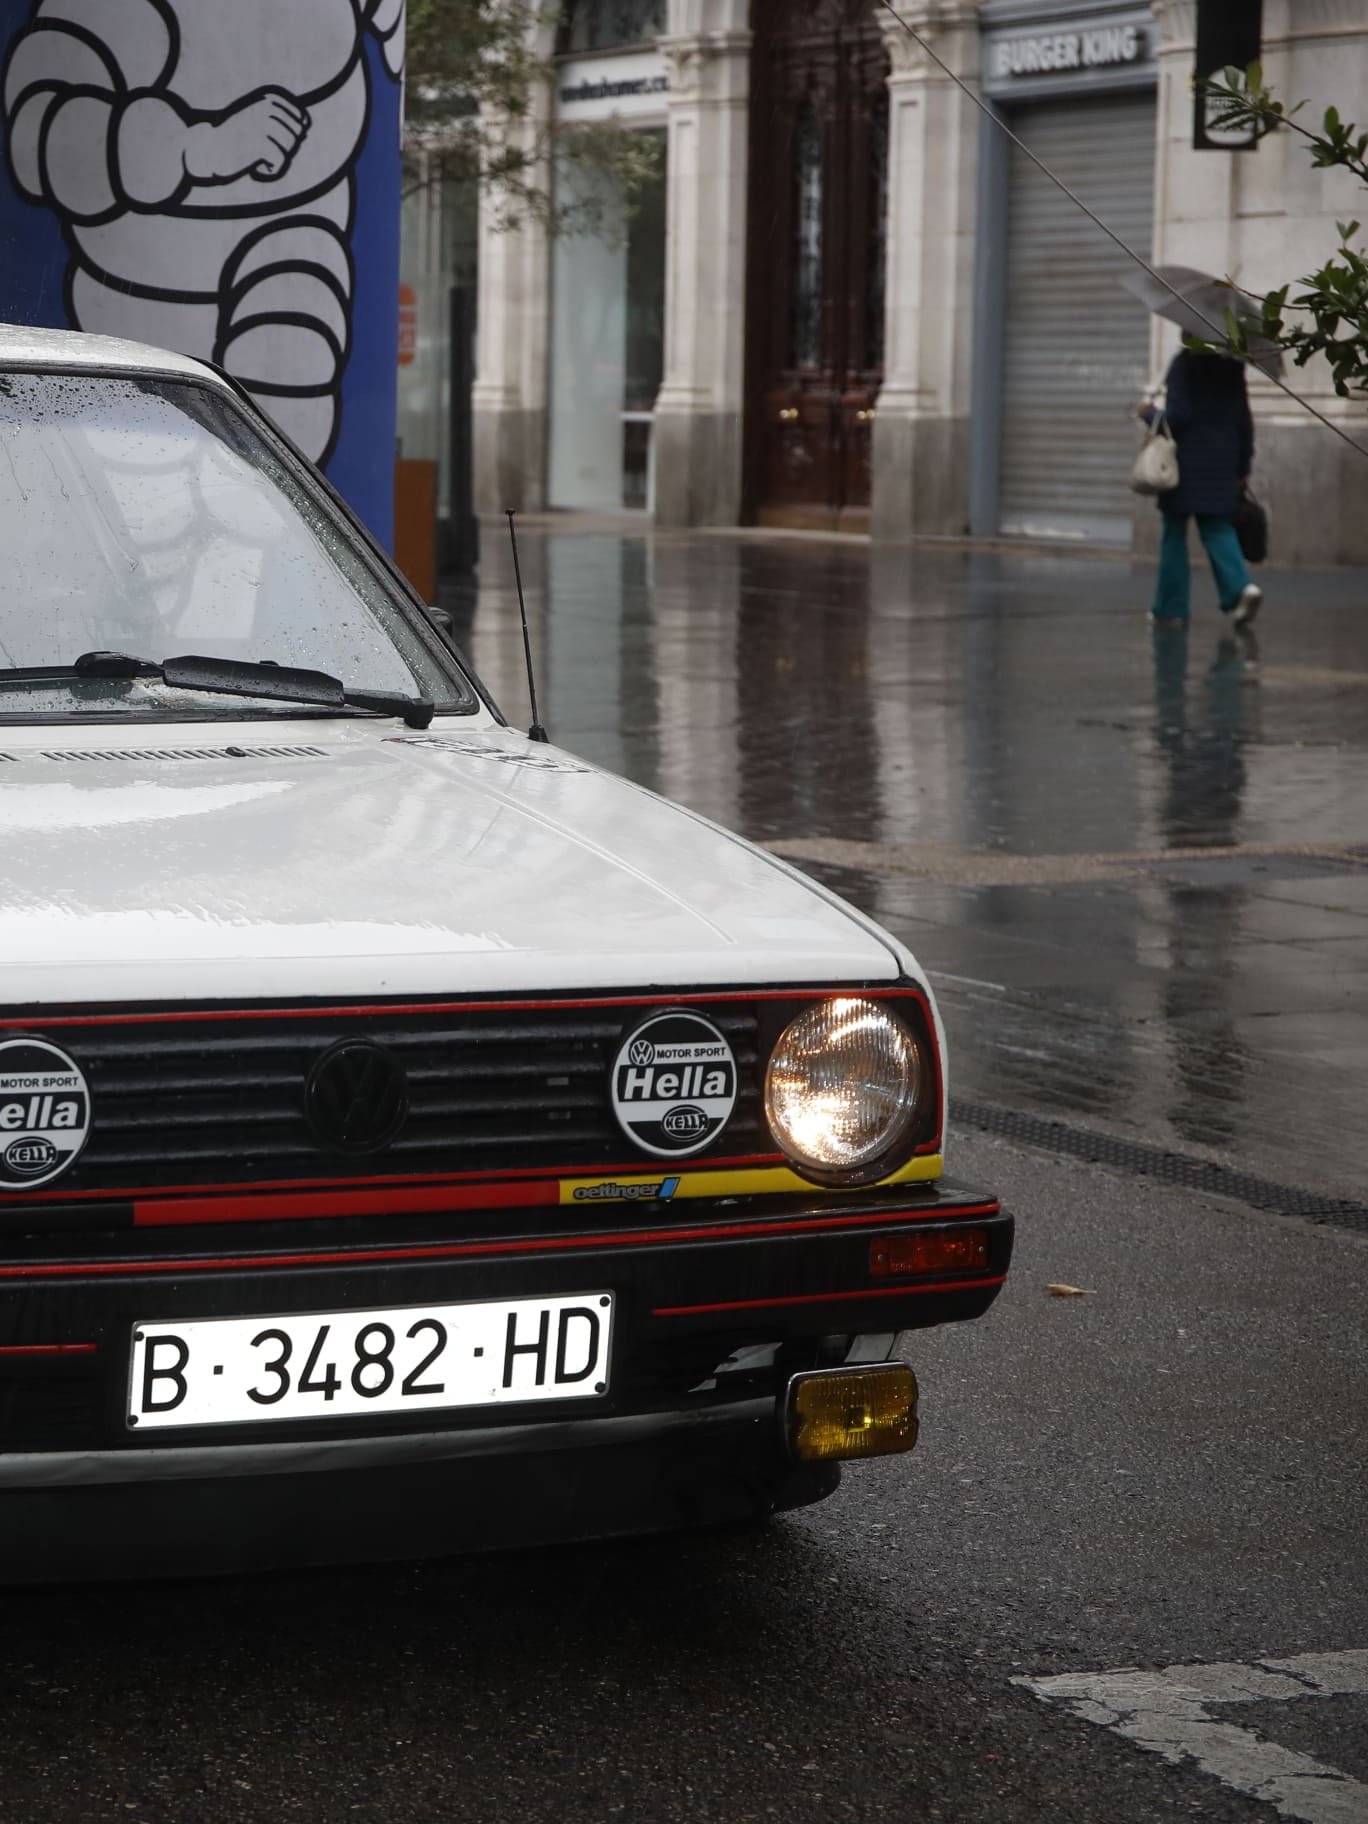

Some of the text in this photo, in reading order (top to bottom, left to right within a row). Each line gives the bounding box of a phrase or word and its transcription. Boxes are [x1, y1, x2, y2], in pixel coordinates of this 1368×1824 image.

[996, 26, 1138, 77] BURGER KING
[656, 1048, 692, 1059] MOTOR
[694, 1047, 726, 1057] SPORT
[0, 1077, 40, 1089] MOTOR
[42, 1076, 79, 1087] SPORT
[624, 1065, 727, 1100] Hella
[574, 1183, 660, 1200] oettinger
